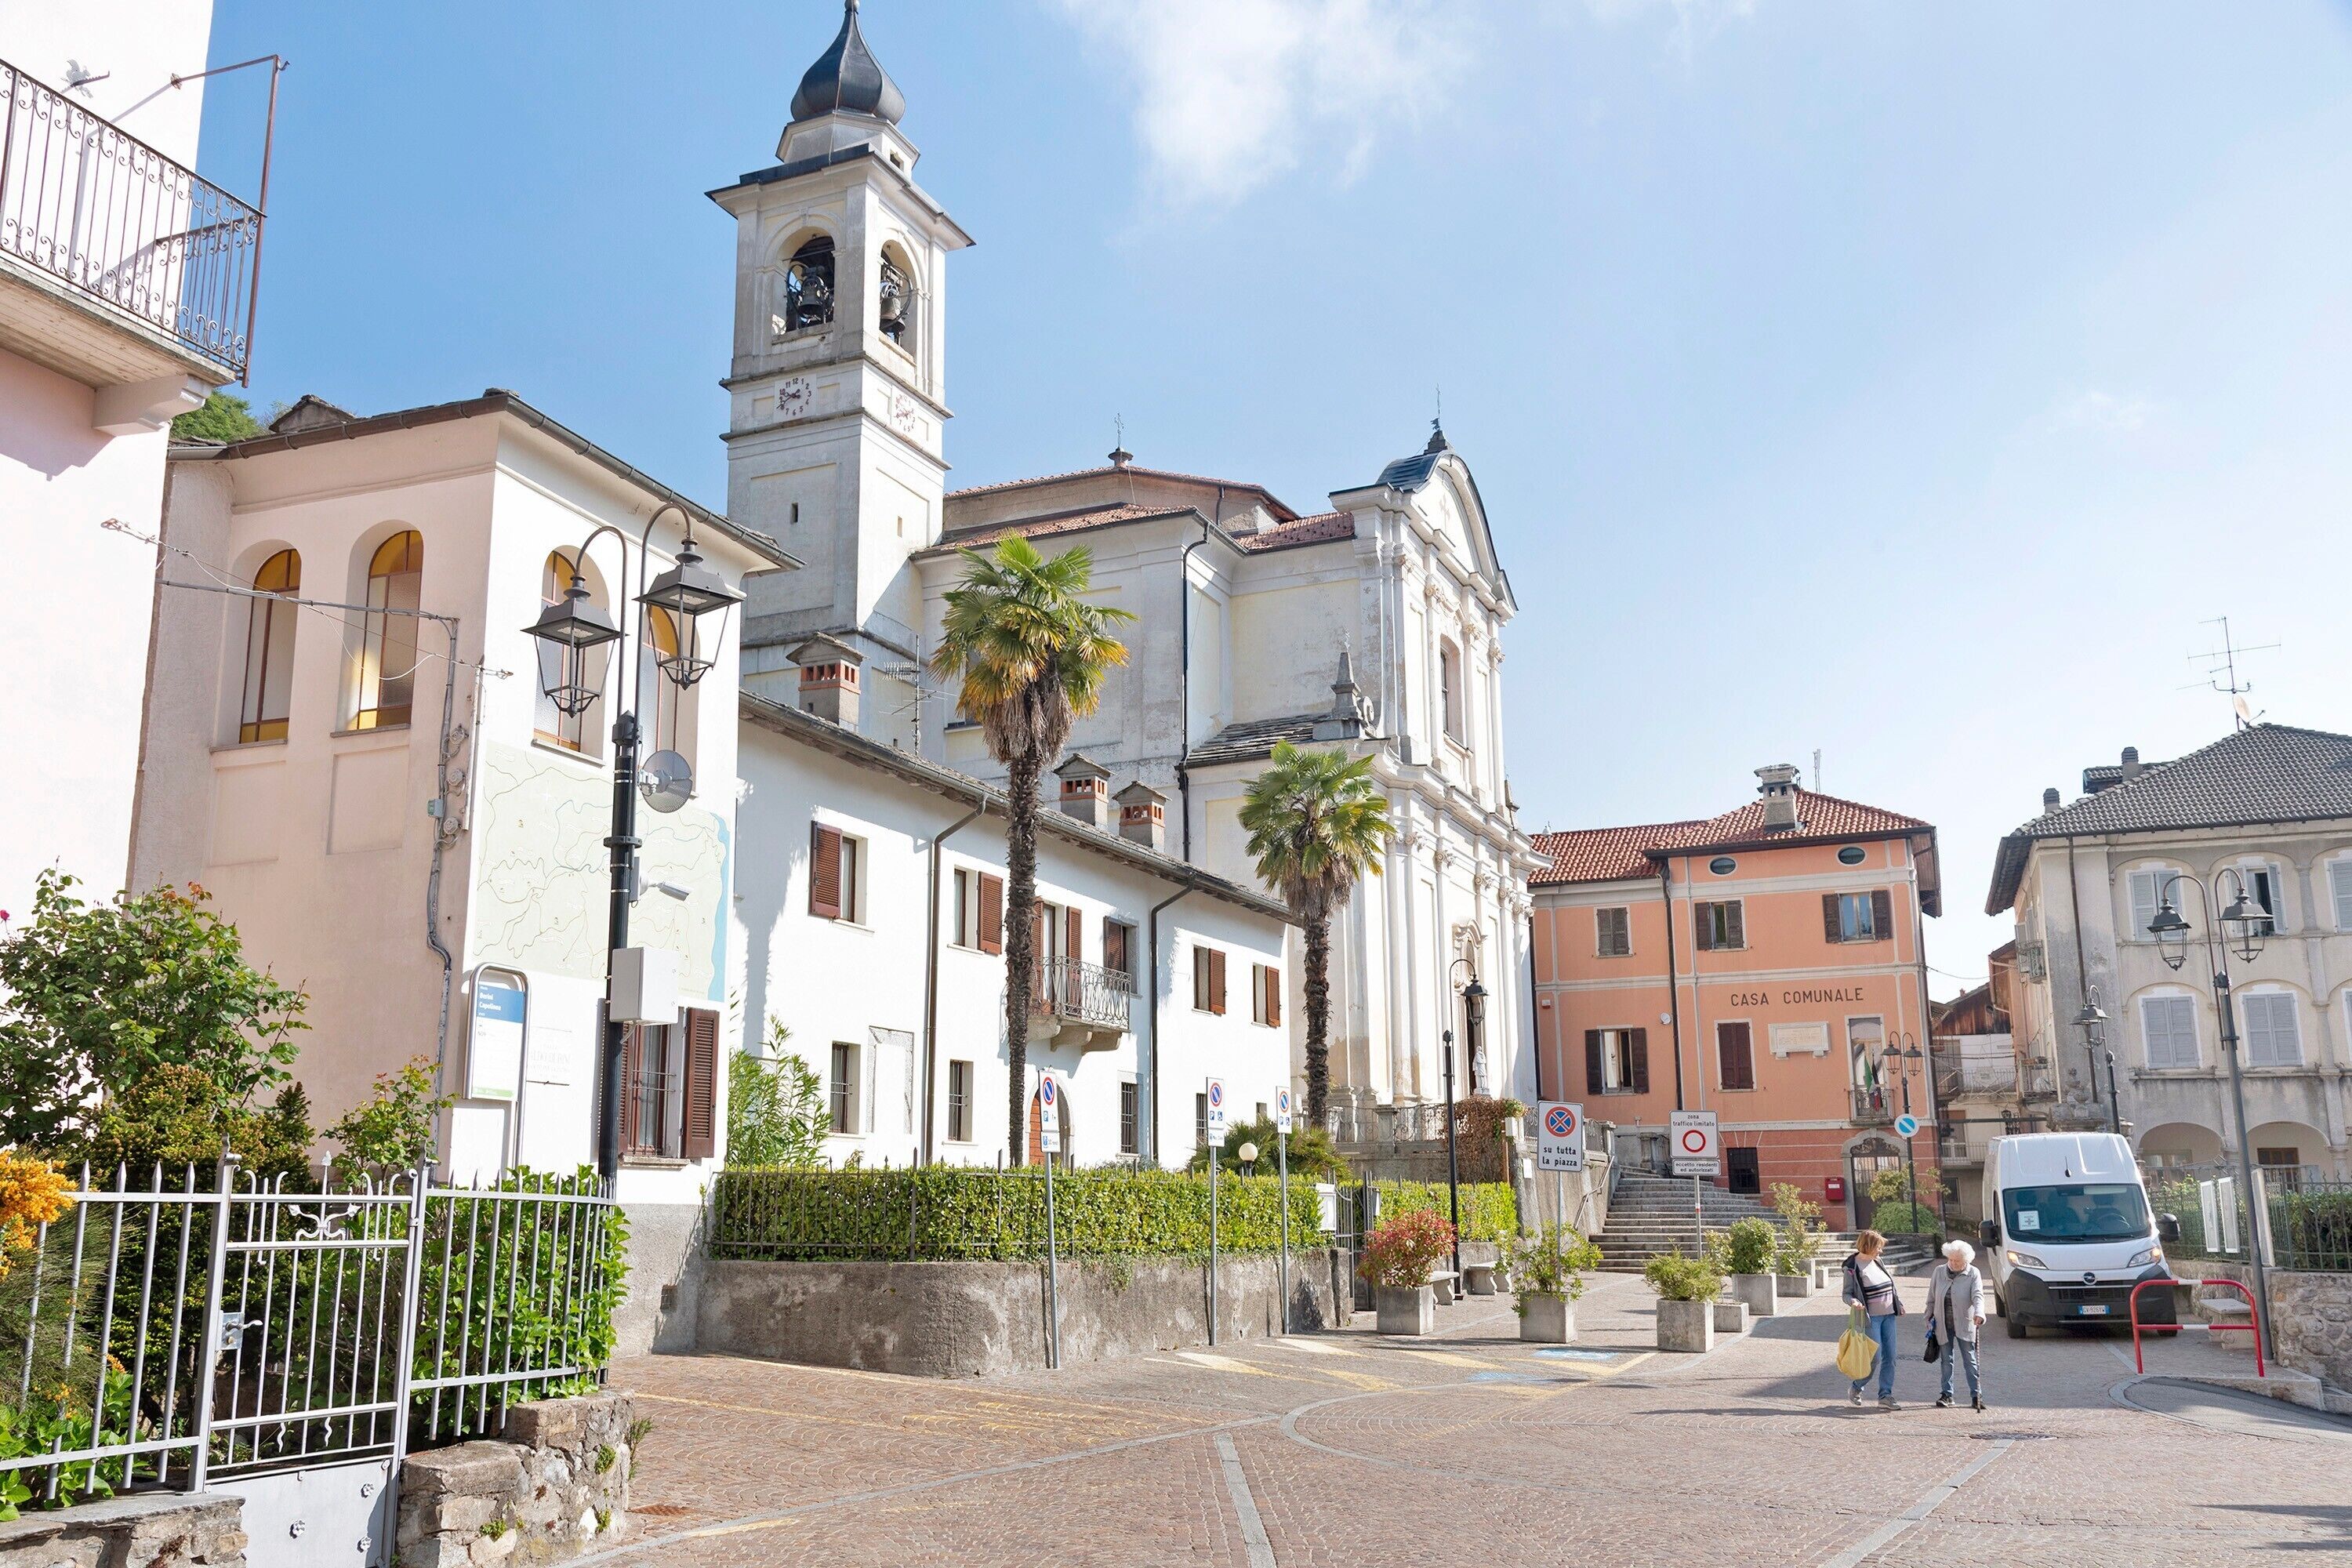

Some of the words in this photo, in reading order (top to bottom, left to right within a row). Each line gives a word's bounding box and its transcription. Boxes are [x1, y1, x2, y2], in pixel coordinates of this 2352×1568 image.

[1730, 992, 1769, 1007] CASA
[1783, 987, 1864, 1004] COMUNALE
[1556, 1145, 1577, 1155] tutta
[1542, 1156, 1550, 1164] la
[1555, 1157, 1577, 1167] piazza
